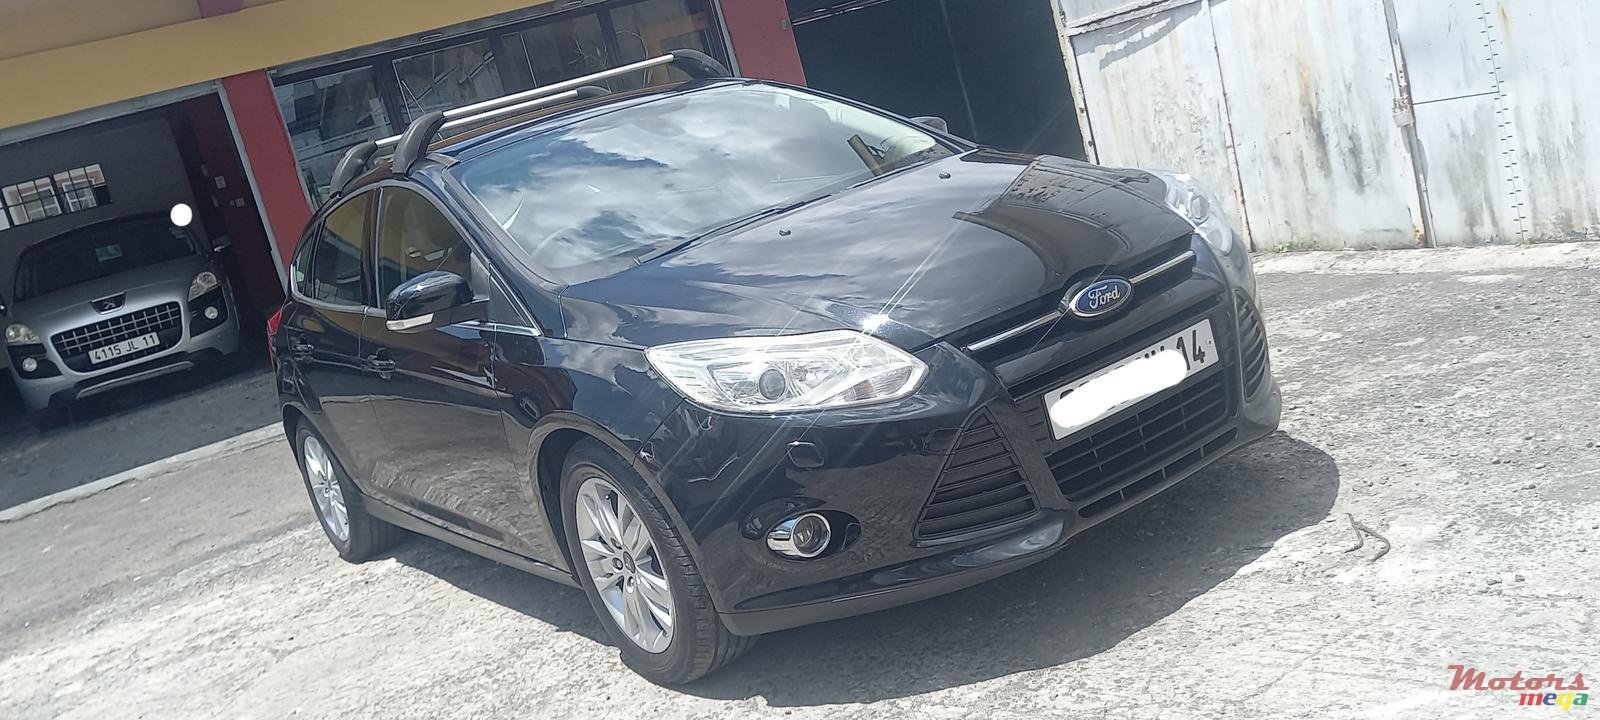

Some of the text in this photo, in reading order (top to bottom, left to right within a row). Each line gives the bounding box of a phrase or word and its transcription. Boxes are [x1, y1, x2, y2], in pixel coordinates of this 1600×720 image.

[1087, 285, 1121, 309] Ford
[94, 334, 157, 361] 4115 JL 11
[1176, 330, 1206, 371] 14
